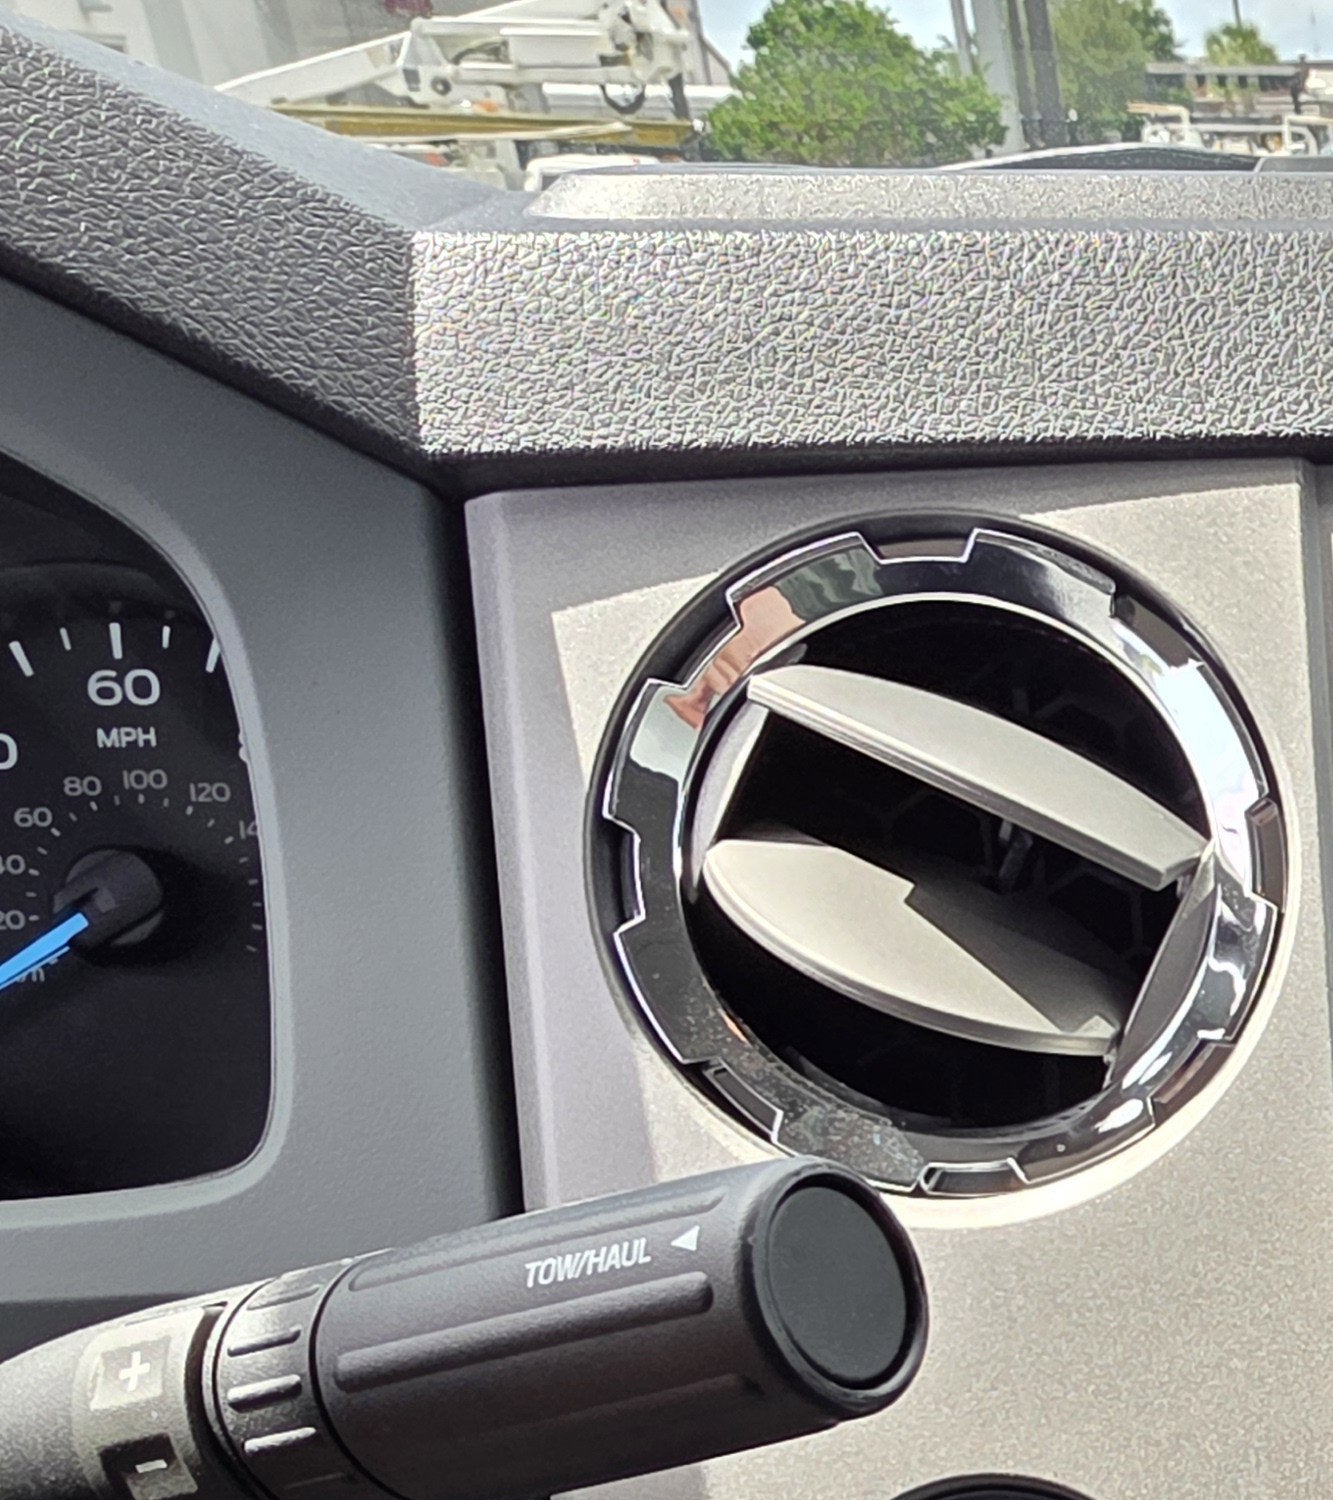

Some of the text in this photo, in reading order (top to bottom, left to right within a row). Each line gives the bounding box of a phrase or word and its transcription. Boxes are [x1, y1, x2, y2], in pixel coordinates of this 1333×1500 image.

[87, 668, 161, 706] 60
[96, 727, 157, 748] MPH
[62, 775, 102, 796] 80
[122, 769, 168, 790] 100
[189, 782, 231, 802] 120
[13, 807, 53, 828] 60
[525, 1237, 652, 1288] TOW/HAUL
